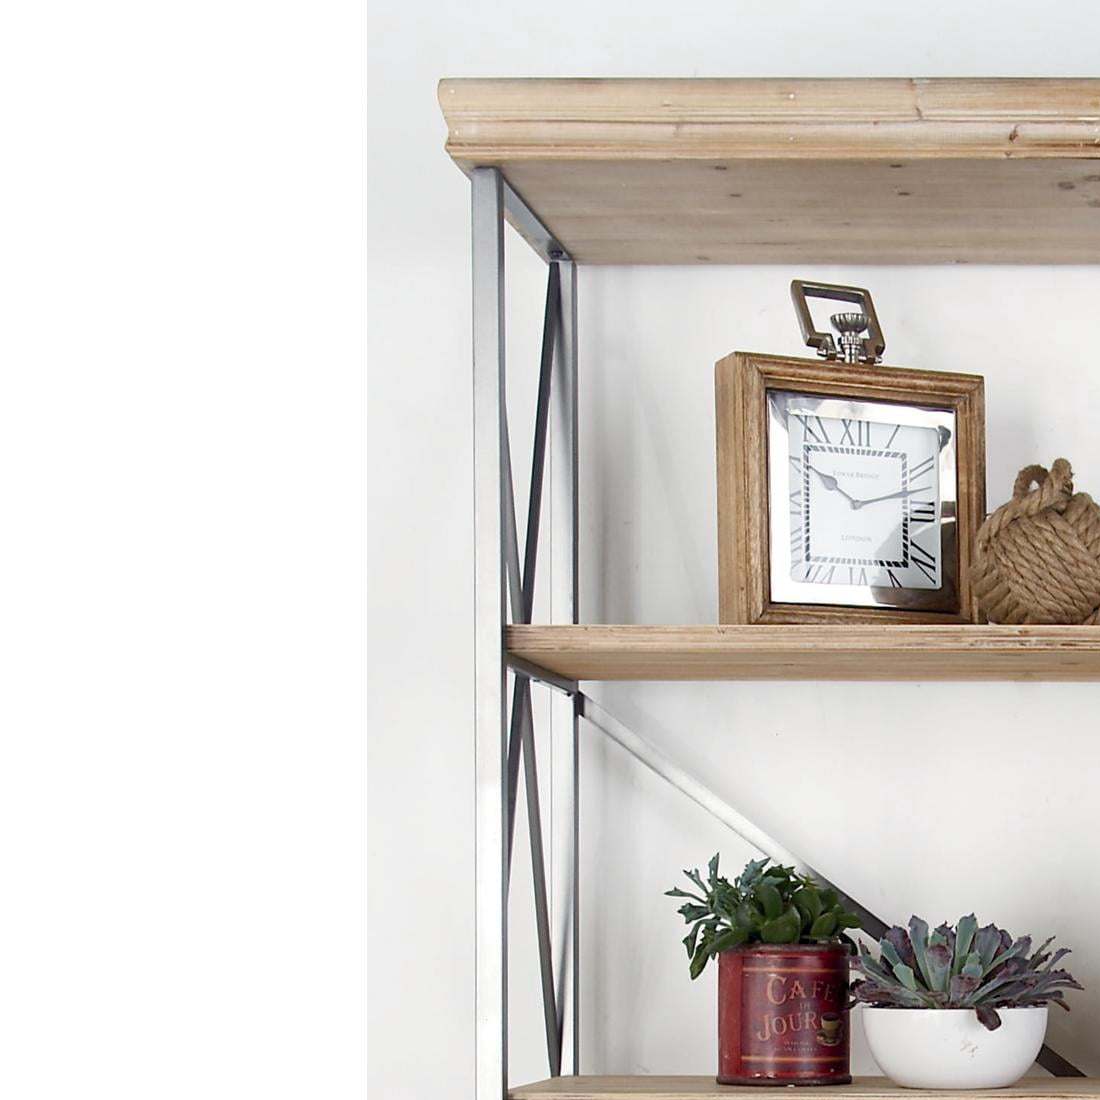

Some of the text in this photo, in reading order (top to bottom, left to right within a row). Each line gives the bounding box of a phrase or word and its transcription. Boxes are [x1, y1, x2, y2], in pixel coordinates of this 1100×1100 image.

[840, 418, 871, 447] XII
[910, 500, 935, 522] III
[840, 534, 873, 543] LONDON
[767, 975, 835, 1005] CAFE
[757, 1011, 818, 1041] JOUR
